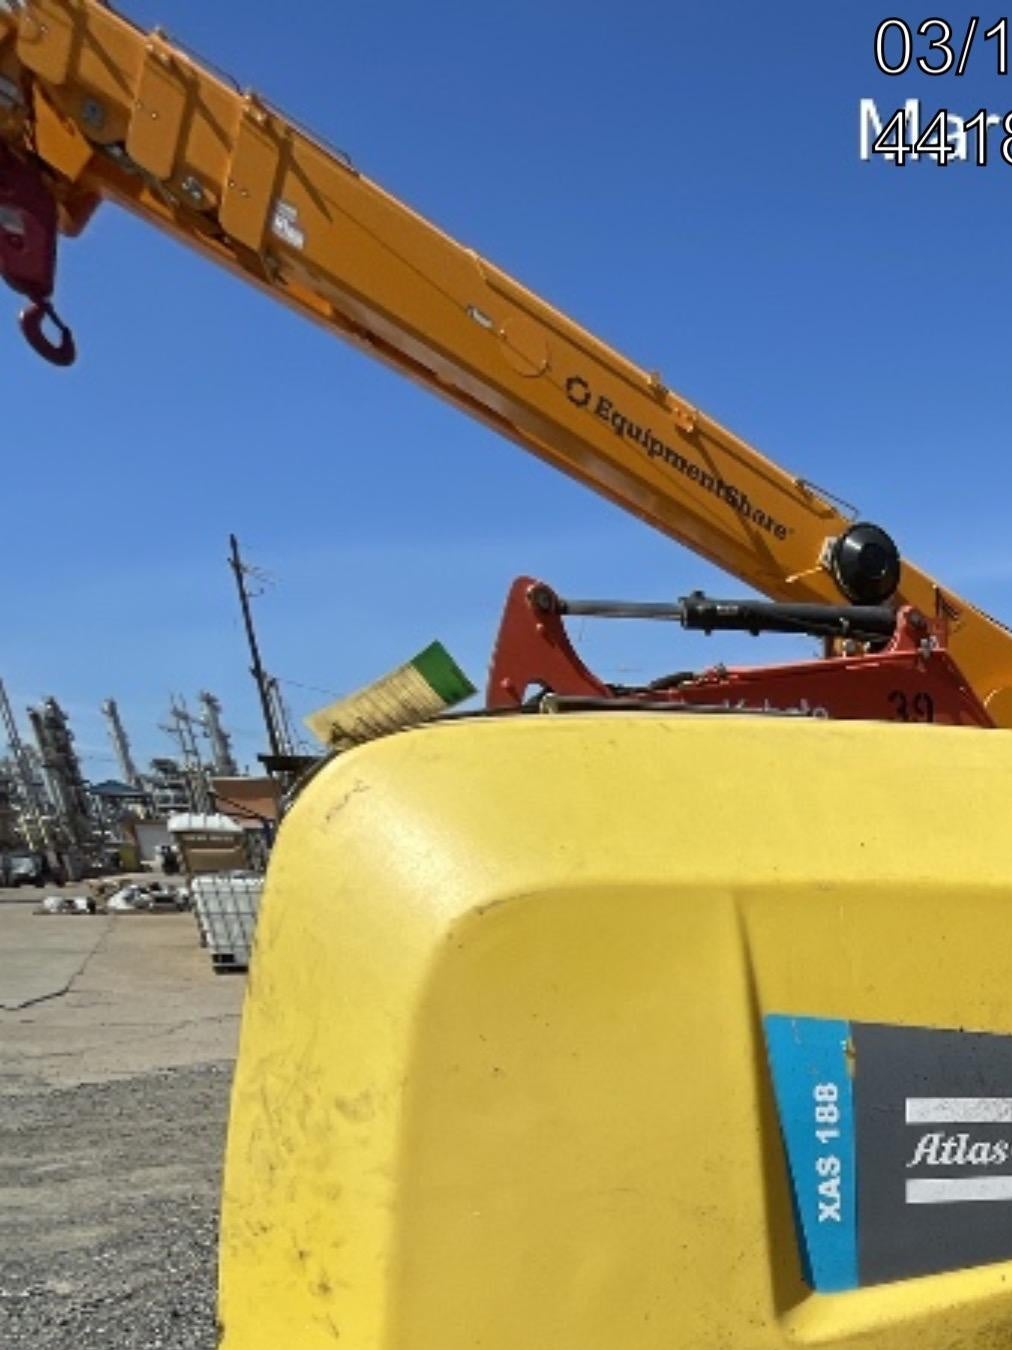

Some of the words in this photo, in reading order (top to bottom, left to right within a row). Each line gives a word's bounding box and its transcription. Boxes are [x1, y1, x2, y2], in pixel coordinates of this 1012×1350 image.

[594, 396, 788, 541] EquipmentShare
[812, 1081, 841, 1144] 188
[905, 1130, 1009, 1168] Atlas
[815, 1154, 841, 1223] XAS
